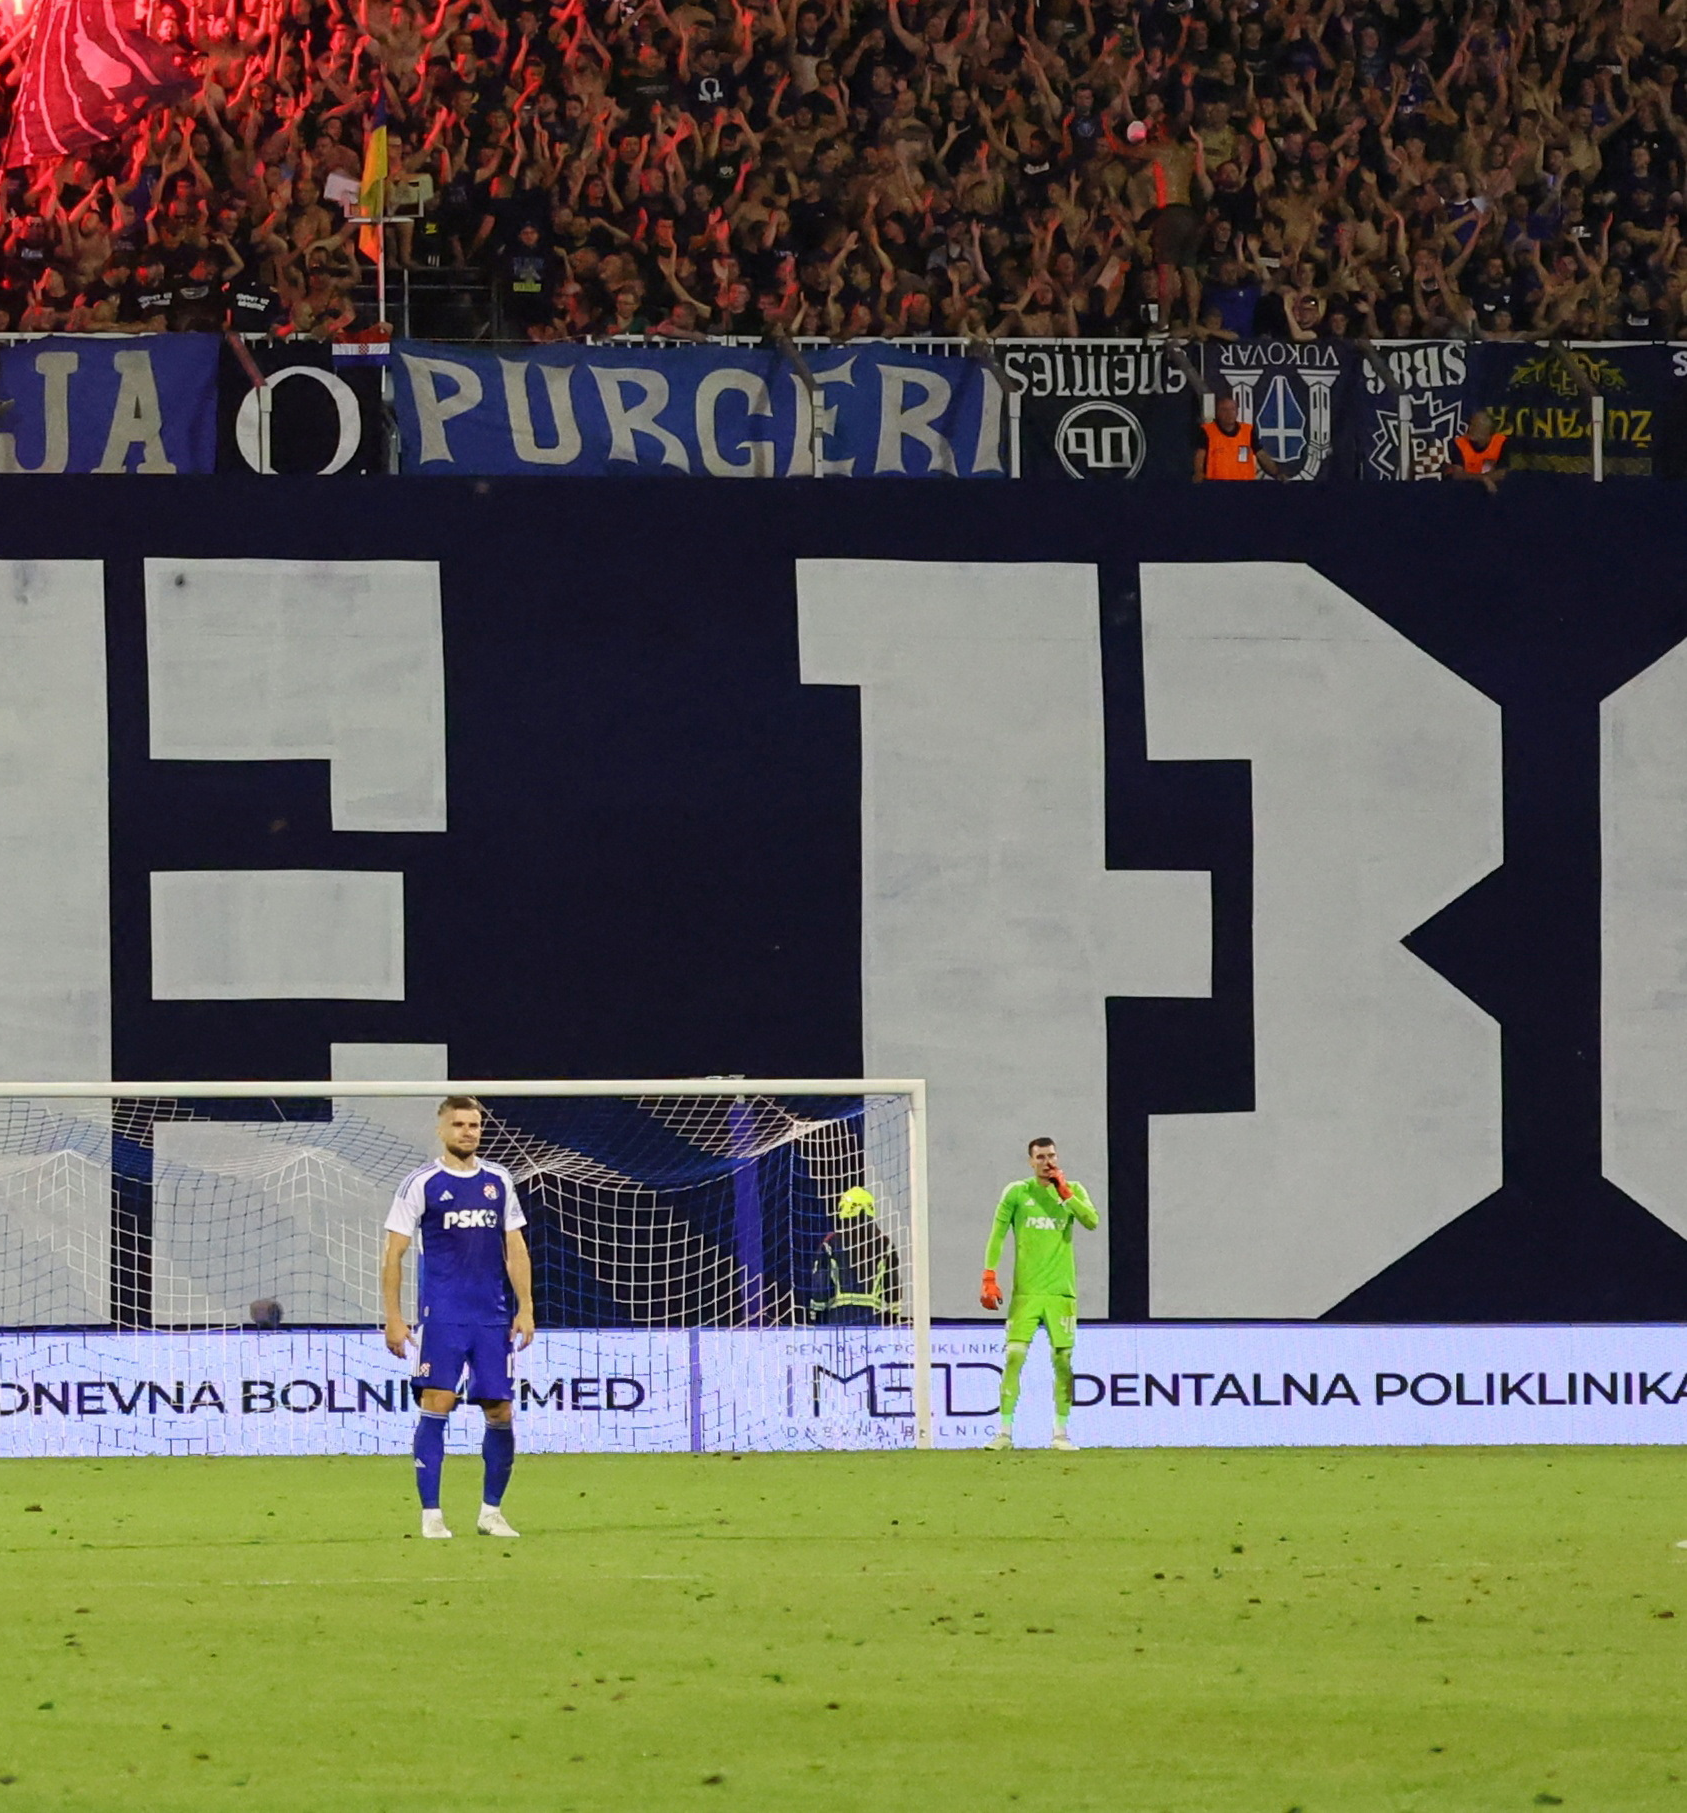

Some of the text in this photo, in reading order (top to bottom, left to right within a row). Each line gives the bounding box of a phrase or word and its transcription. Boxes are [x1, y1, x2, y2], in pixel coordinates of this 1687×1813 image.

[1219, 341, 1341, 367] VUKOVAR
[443, 1210, 486, 1230] PSK
[1070, 1372, 1363, 1408] DENTALNA
